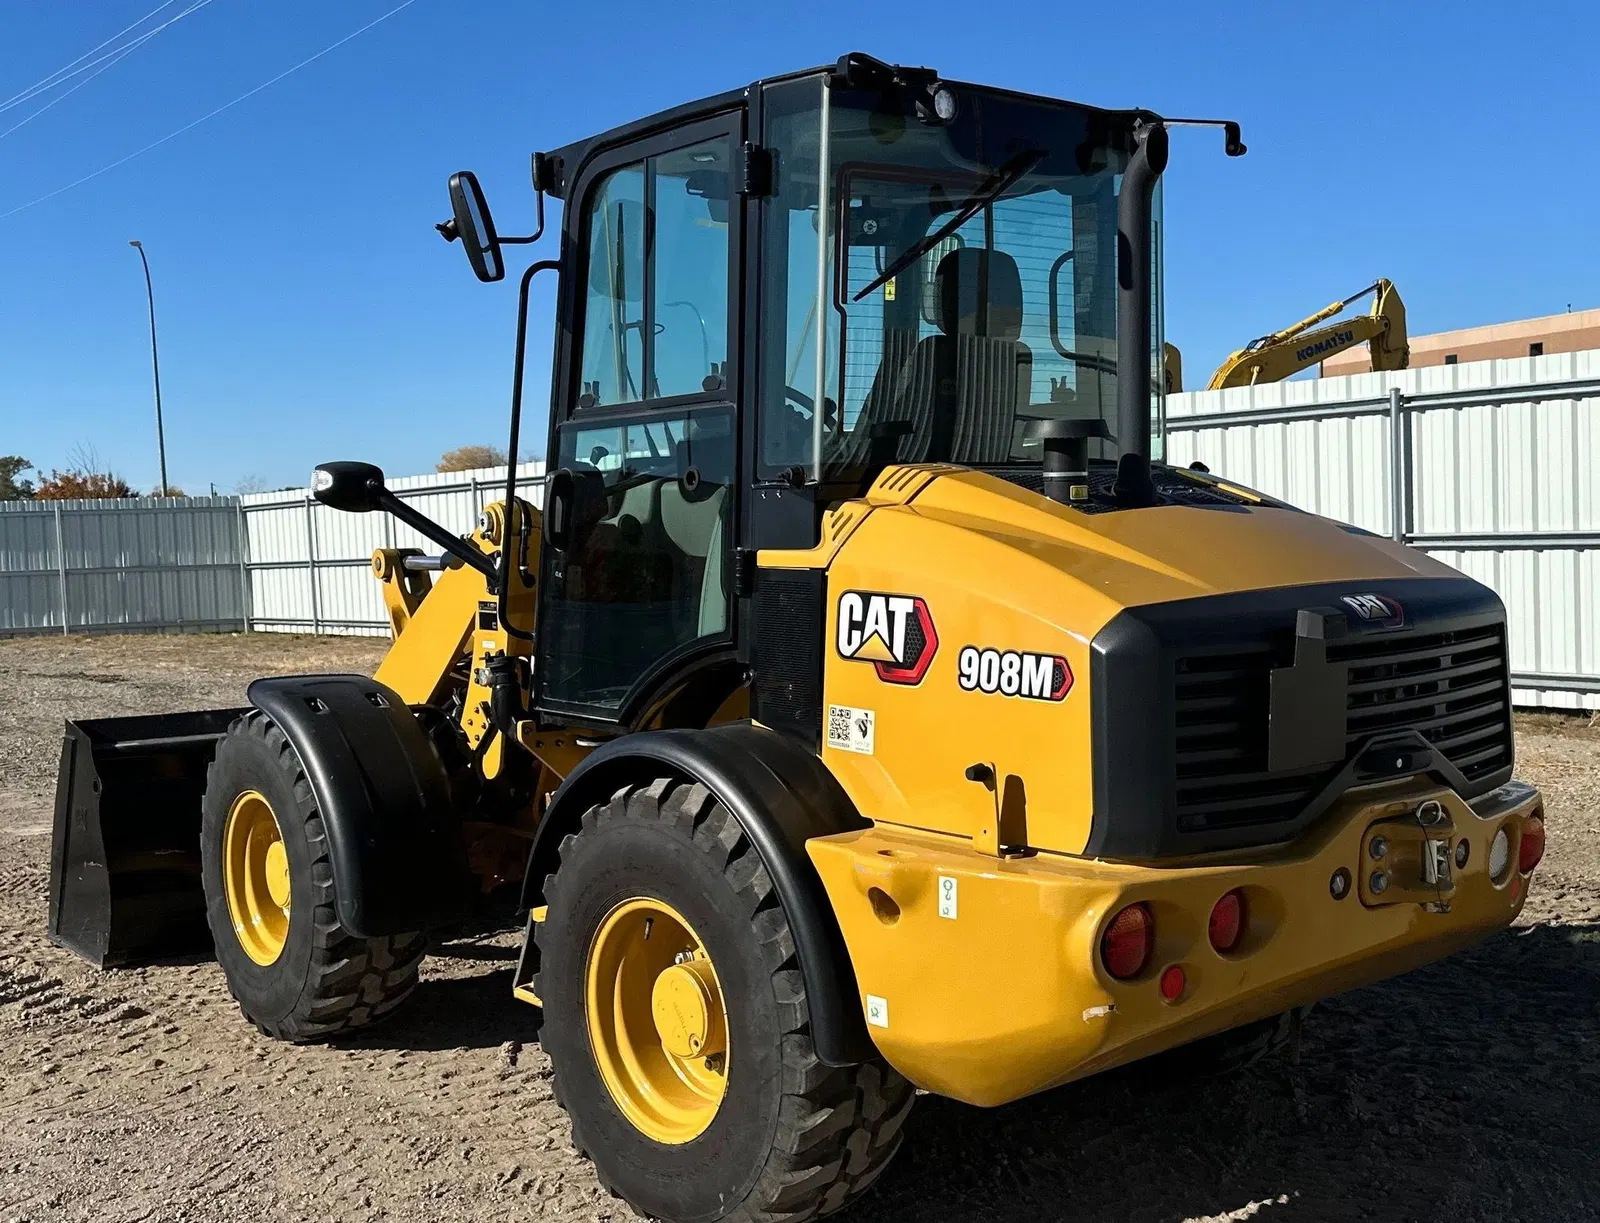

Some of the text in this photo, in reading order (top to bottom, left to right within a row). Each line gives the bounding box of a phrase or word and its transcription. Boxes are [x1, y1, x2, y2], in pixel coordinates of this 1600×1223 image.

[1297, 330, 1353, 361] KOMATSU
[1342, 595, 1392, 619] CAT
[838, 593, 914, 663] CAT
[960, 648, 1054, 698] 908M
